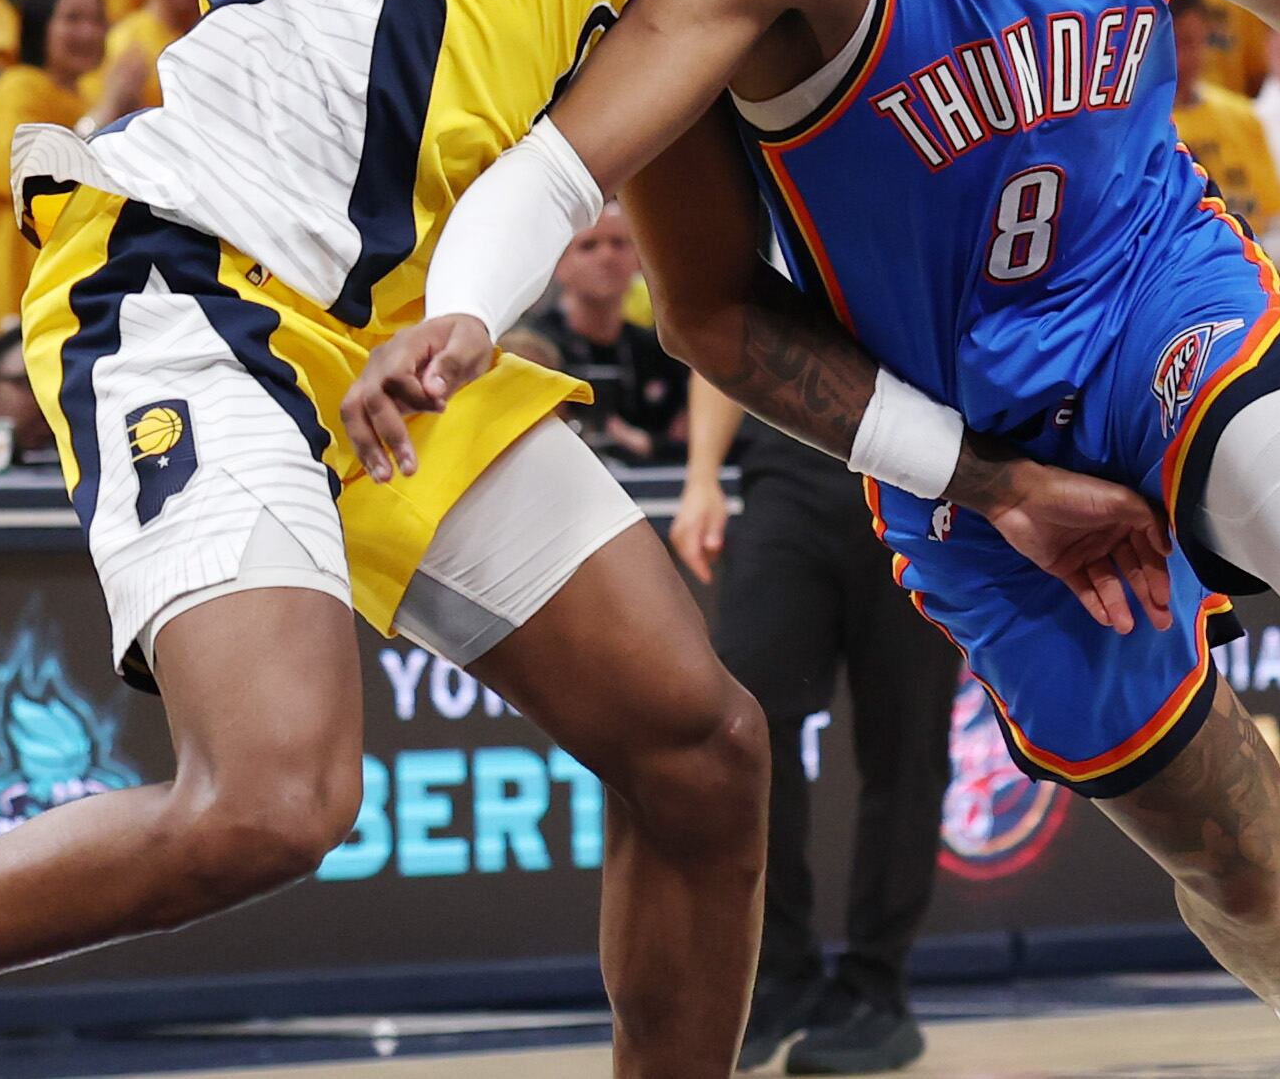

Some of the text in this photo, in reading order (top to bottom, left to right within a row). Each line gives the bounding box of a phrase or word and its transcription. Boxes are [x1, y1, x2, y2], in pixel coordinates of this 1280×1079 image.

[868, 6, 1157, 173] THUNDER
[985, 163, 1066, 286] 8
[1163, 335, 1196, 421] OKC
[377, 647, 524, 720] YO
